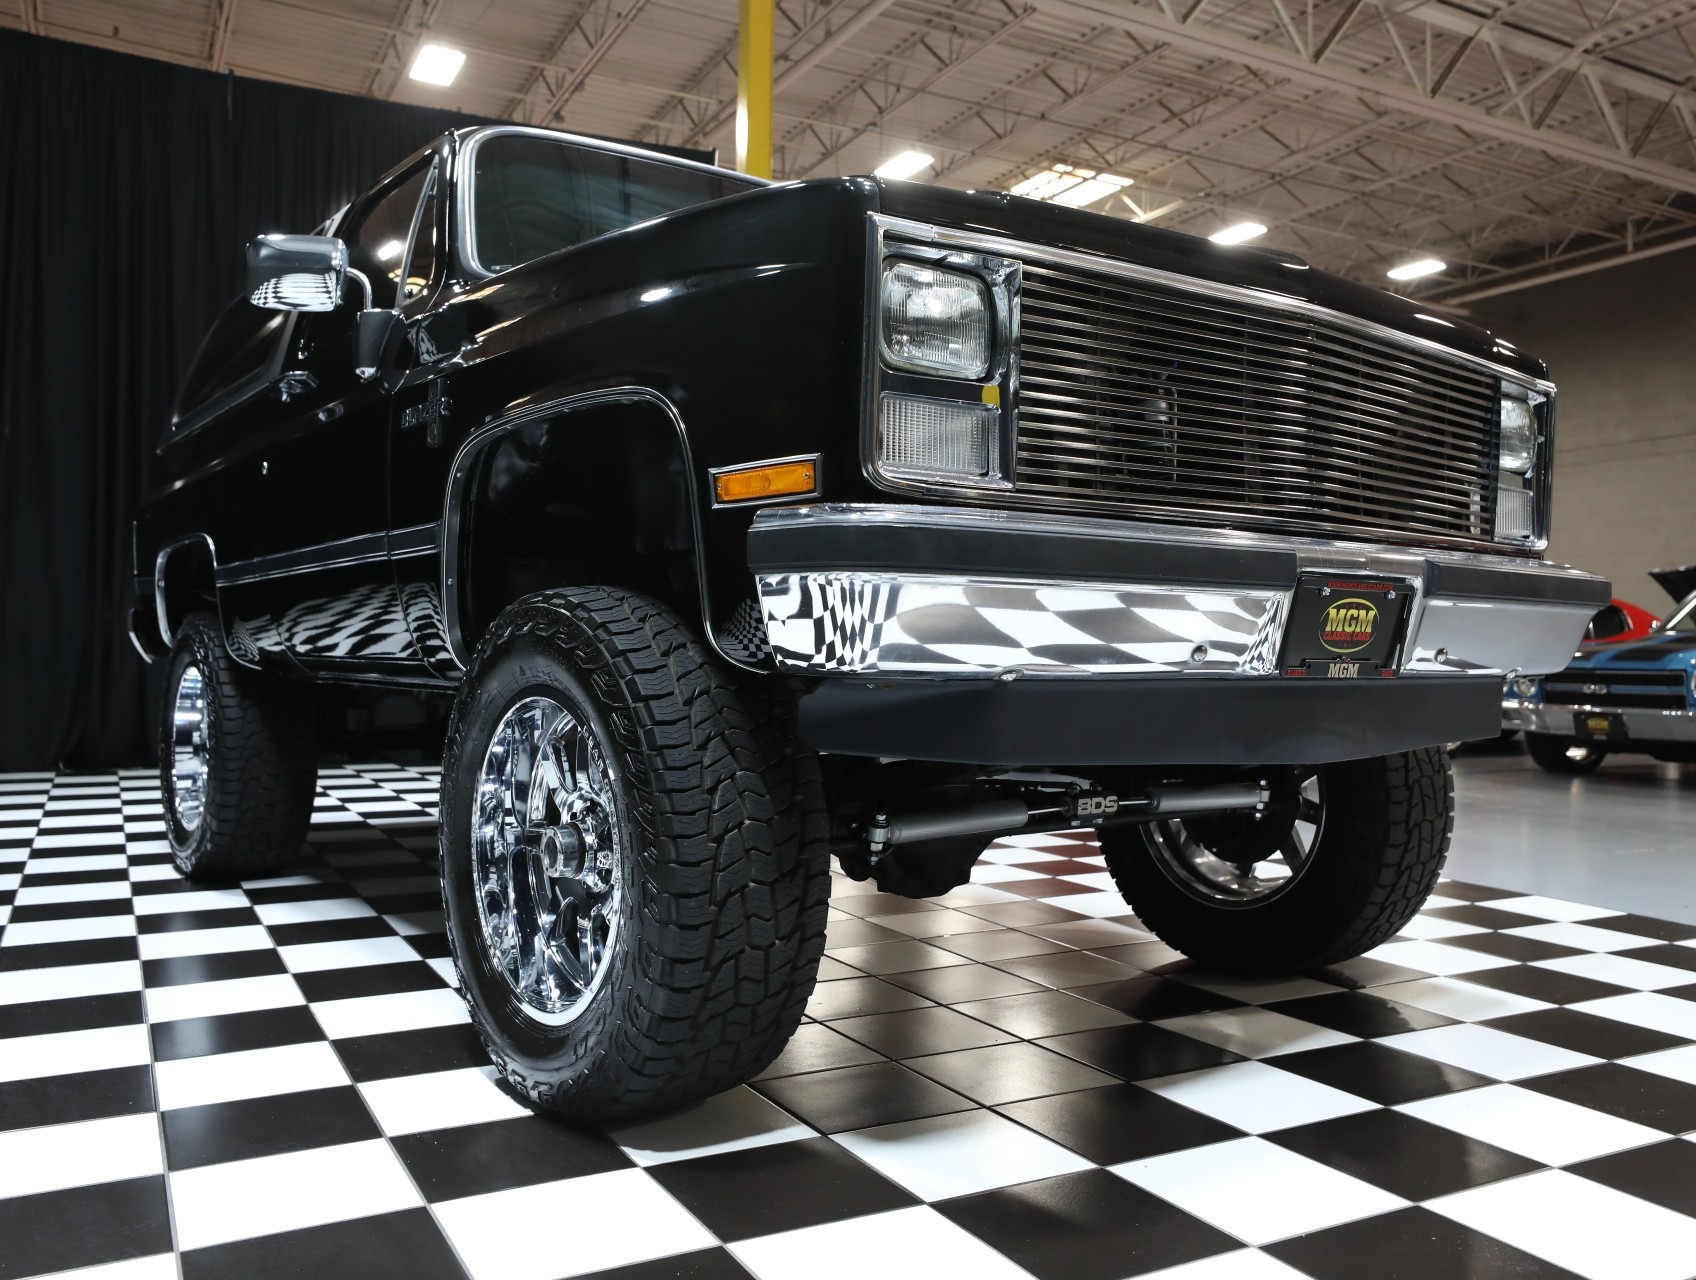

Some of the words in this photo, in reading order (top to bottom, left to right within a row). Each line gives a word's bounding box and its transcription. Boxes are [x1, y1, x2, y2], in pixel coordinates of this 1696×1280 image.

[1325, 608, 1376, 632] MGM
[1323, 631, 1351, 640] CLASSIC
[1353, 632, 1370, 640] CARS
[1327, 663, 1360, 678] MGM
[1078, 796, 1118, 815] BDS
